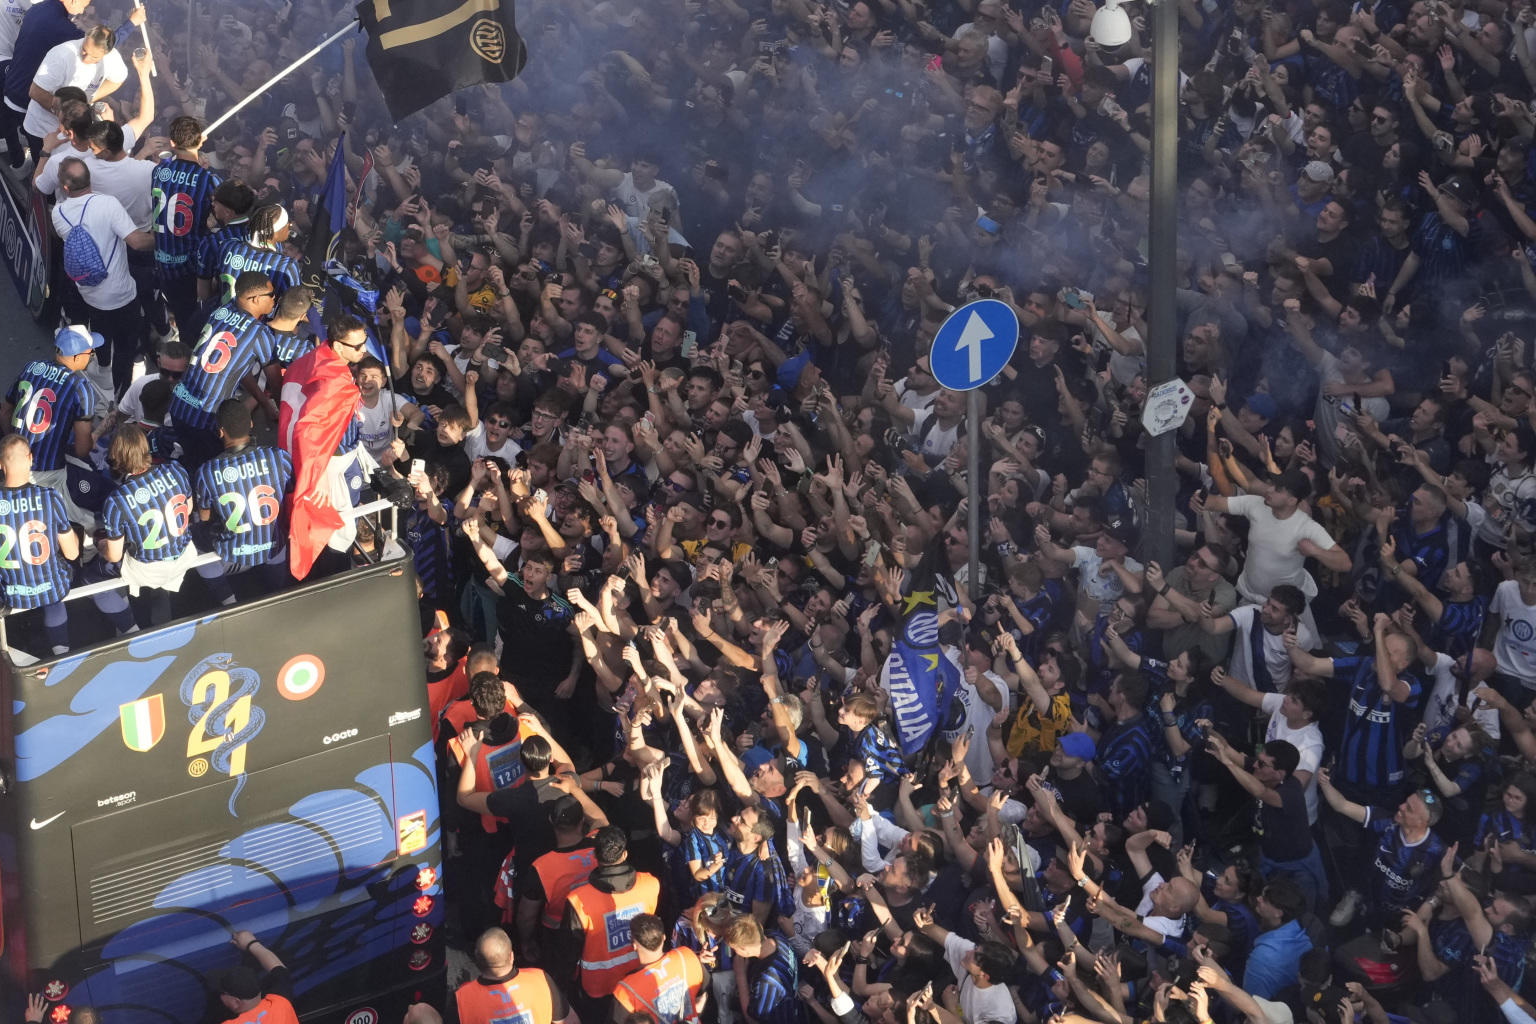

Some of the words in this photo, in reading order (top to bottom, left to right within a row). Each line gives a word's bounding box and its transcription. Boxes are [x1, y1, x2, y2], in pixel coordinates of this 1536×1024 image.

[151, 186, 195, 238] 26
[26, 360, 70, 386] DOUBLE
[192, 323, 238, 374] 26
[11, 380, 56, 435] 26
[125, 471, 178, 510] DOUBLE
[214, 458, 270, 486] DOUBLE
[137, 493, 190, 551] 26
[218, 484, 280, 534] 26
[187, 669, 252, 777] 21
[97, 790, 137, 808] betsson
